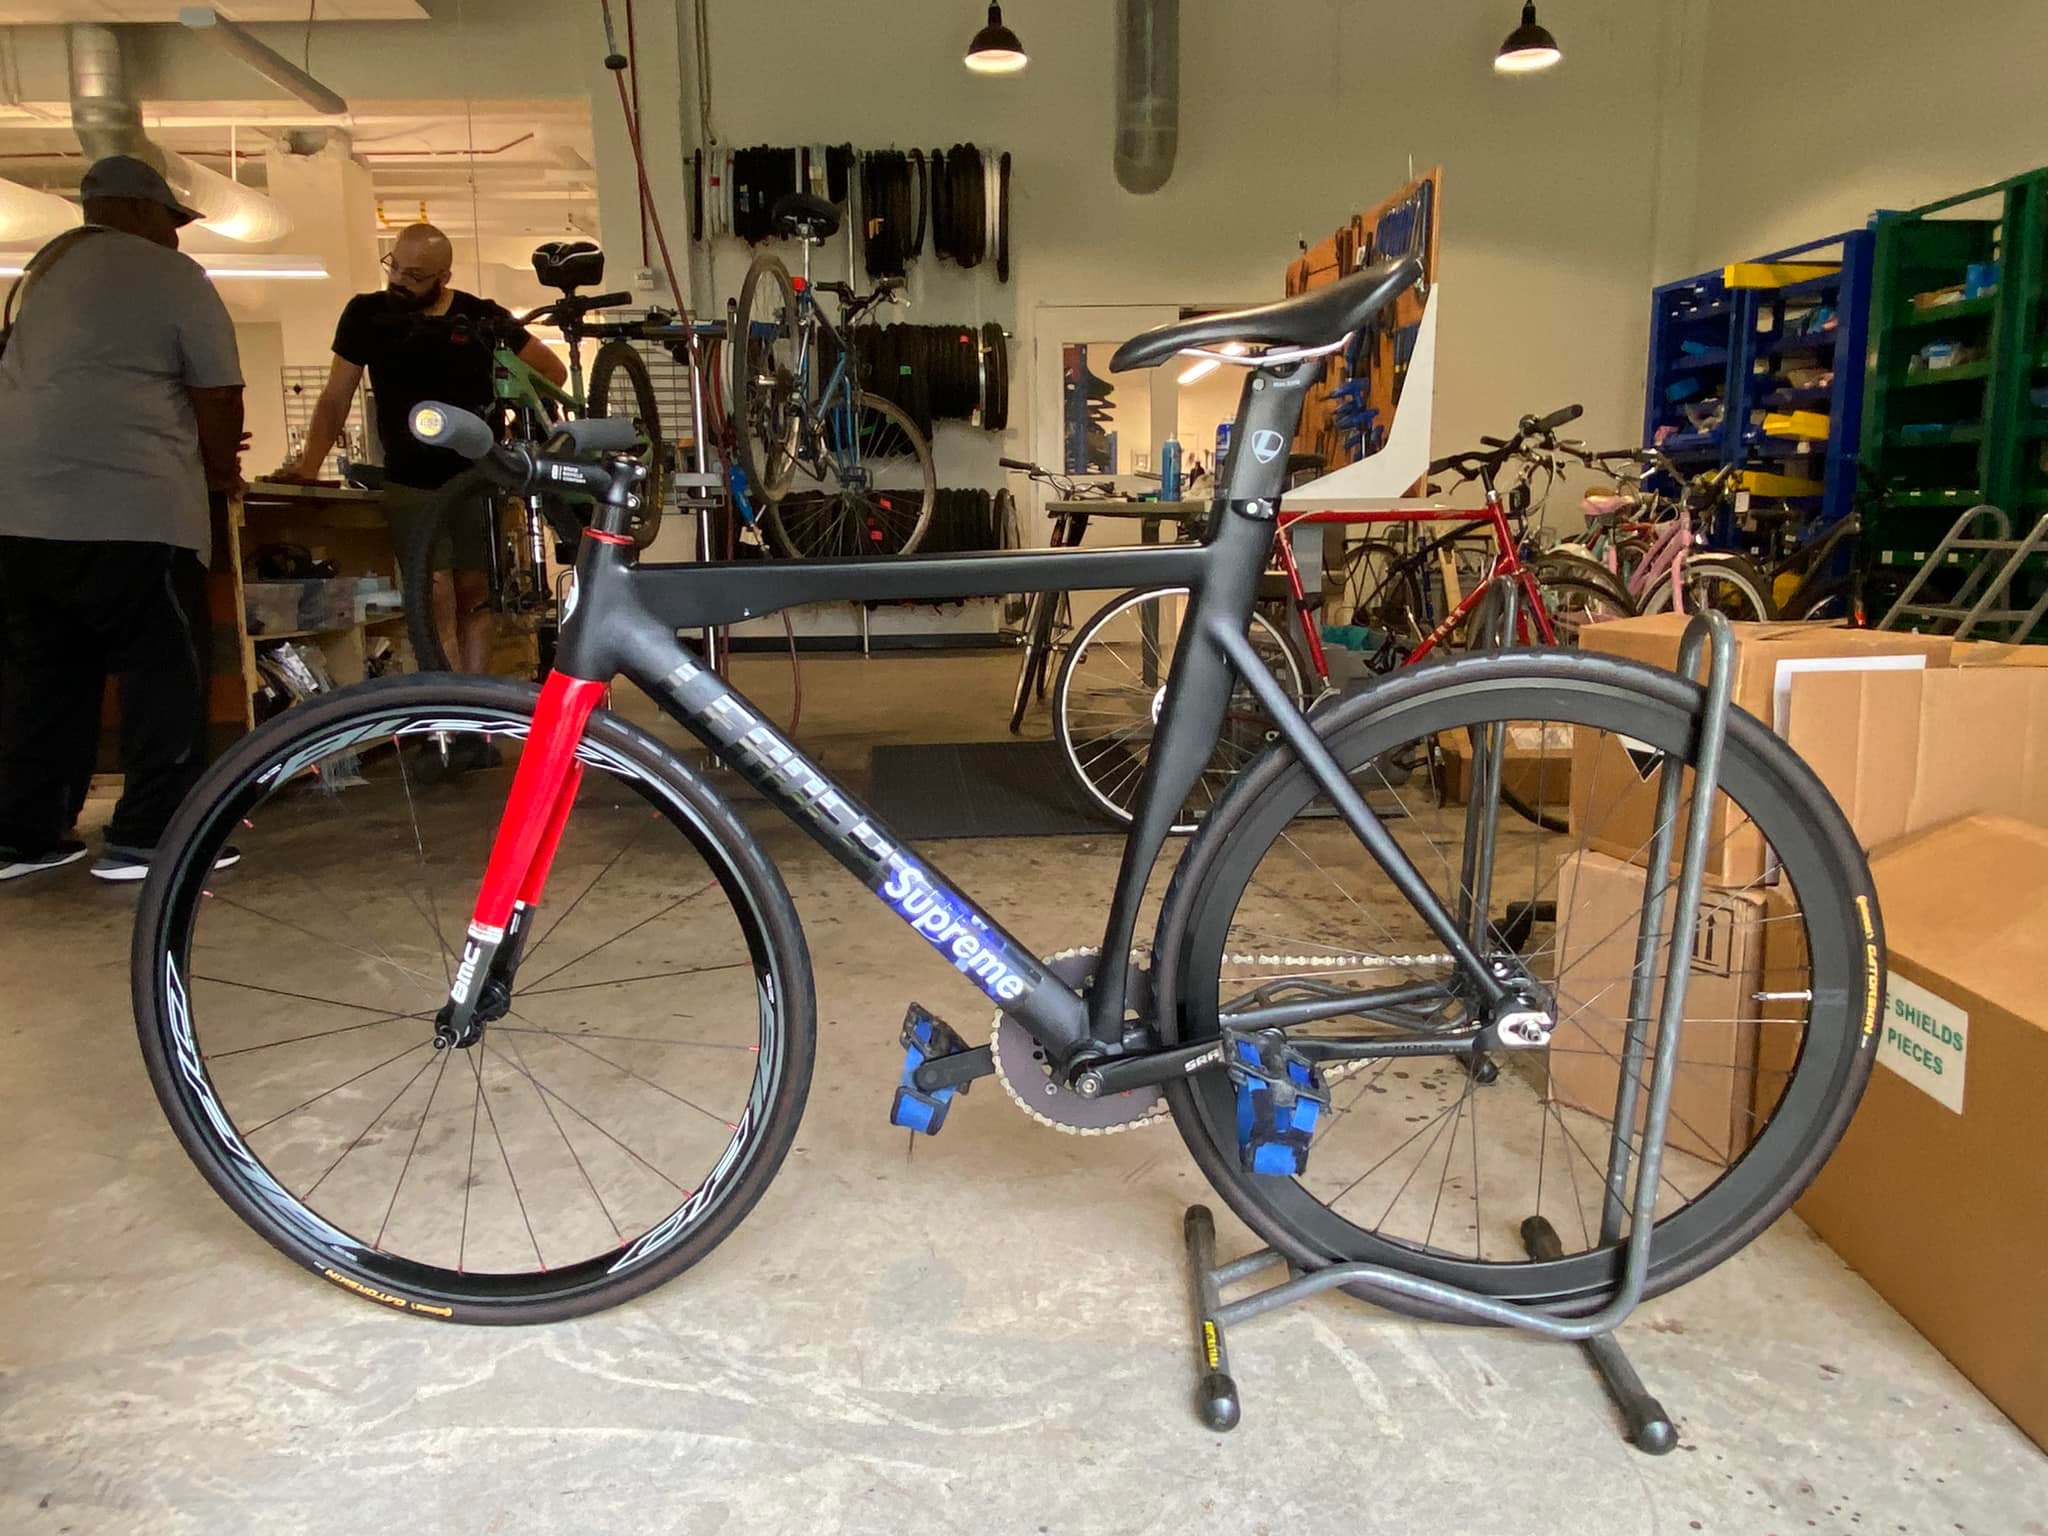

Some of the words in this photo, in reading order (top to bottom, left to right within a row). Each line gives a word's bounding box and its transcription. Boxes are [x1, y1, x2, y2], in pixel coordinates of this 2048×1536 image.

[884, 867, 1024, 999] Supreme
[1888, 1027, 1944, 1076] PIECES
[1895, 998, 1964, 1053] SHIELDS
[1184, 1048, 1222, 1072] SRA
